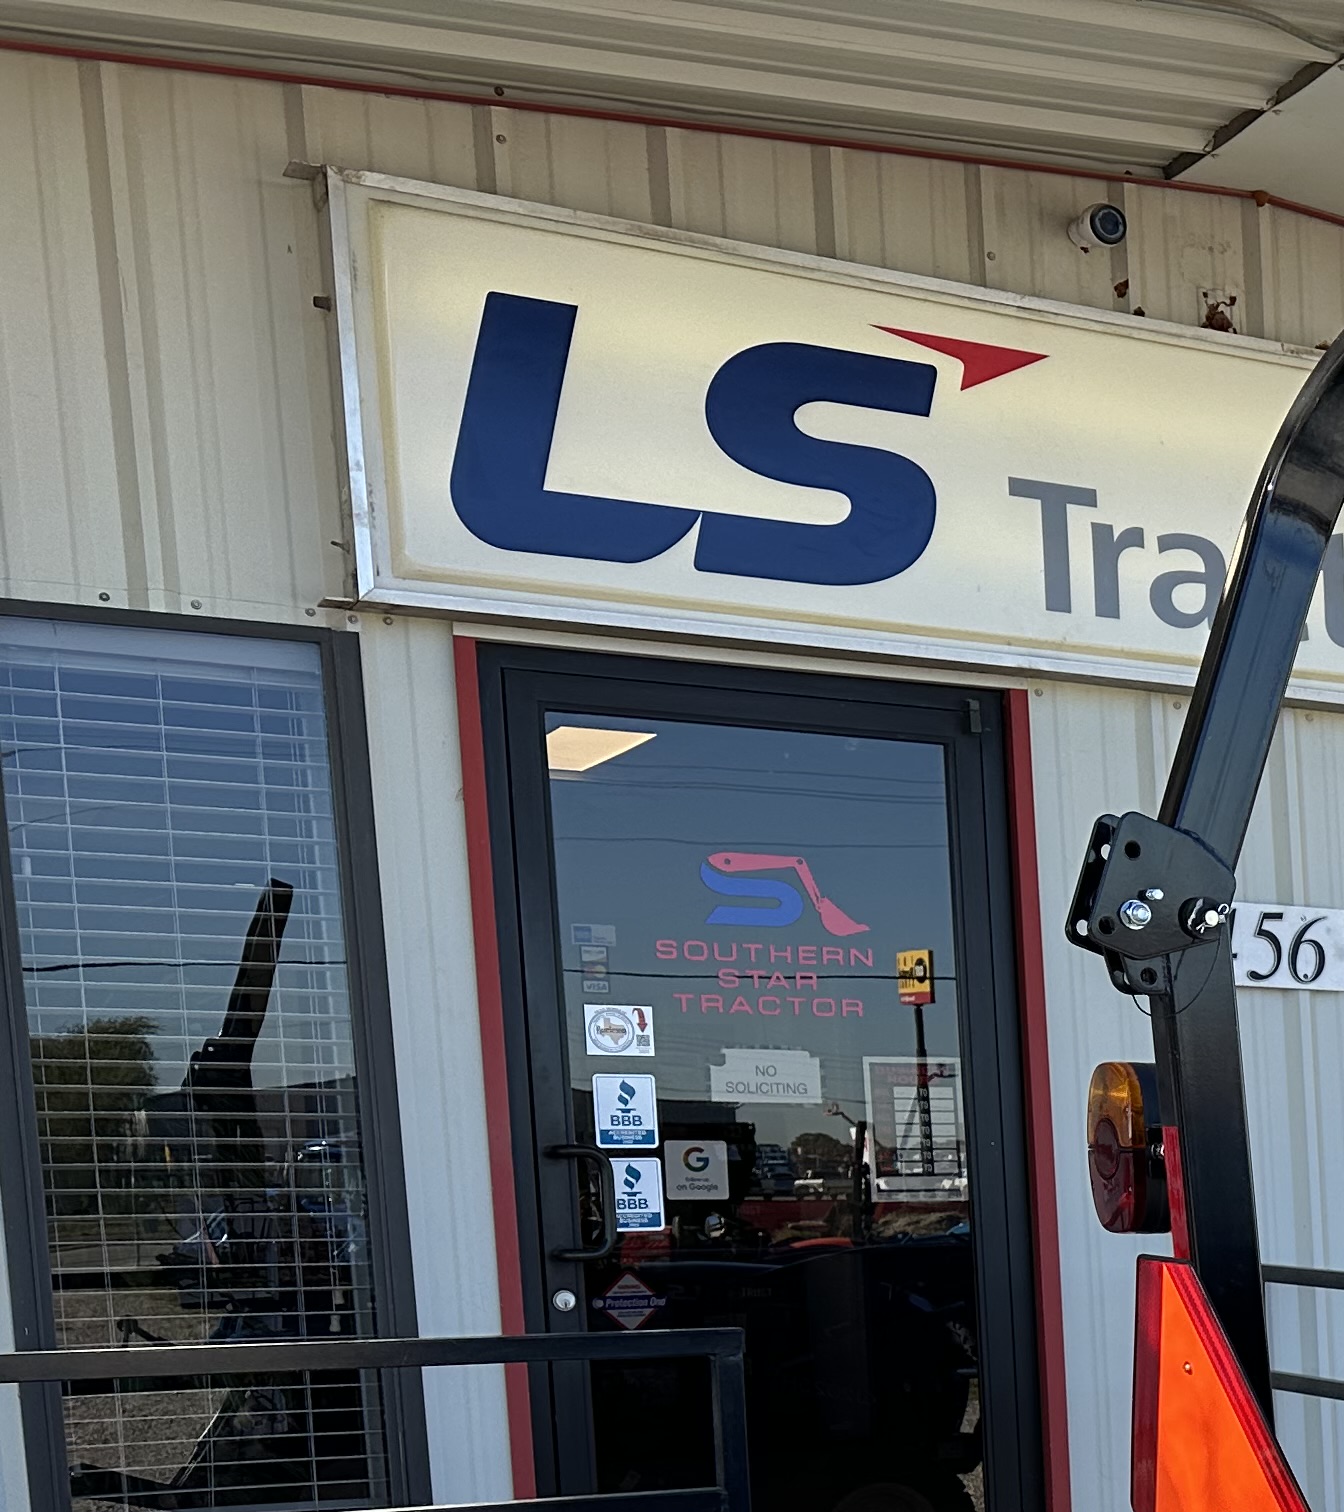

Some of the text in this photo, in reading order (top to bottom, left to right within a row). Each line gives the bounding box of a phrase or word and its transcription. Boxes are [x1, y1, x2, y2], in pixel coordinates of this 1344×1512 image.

[450, 290, 938, 587] LS
[1229, 908, 1328, 984] 56
[655, 939, 874, 967] SOUTHERN
[717, 968, 817, 990] STAR
[585, 983, 607, 991] VISA
[672, 993, 864, 1017] TRACTOR
[755, 1065, 777, 1078] NO
[725, 1081, 808, 1095] SOLICITING
[610, 1114, 643, 1127] BBB
[688, 1182, 719, 1193] Google
[616, 1198, 649, 1210] BBB
[605, 1298, 649, 1309] Protection
